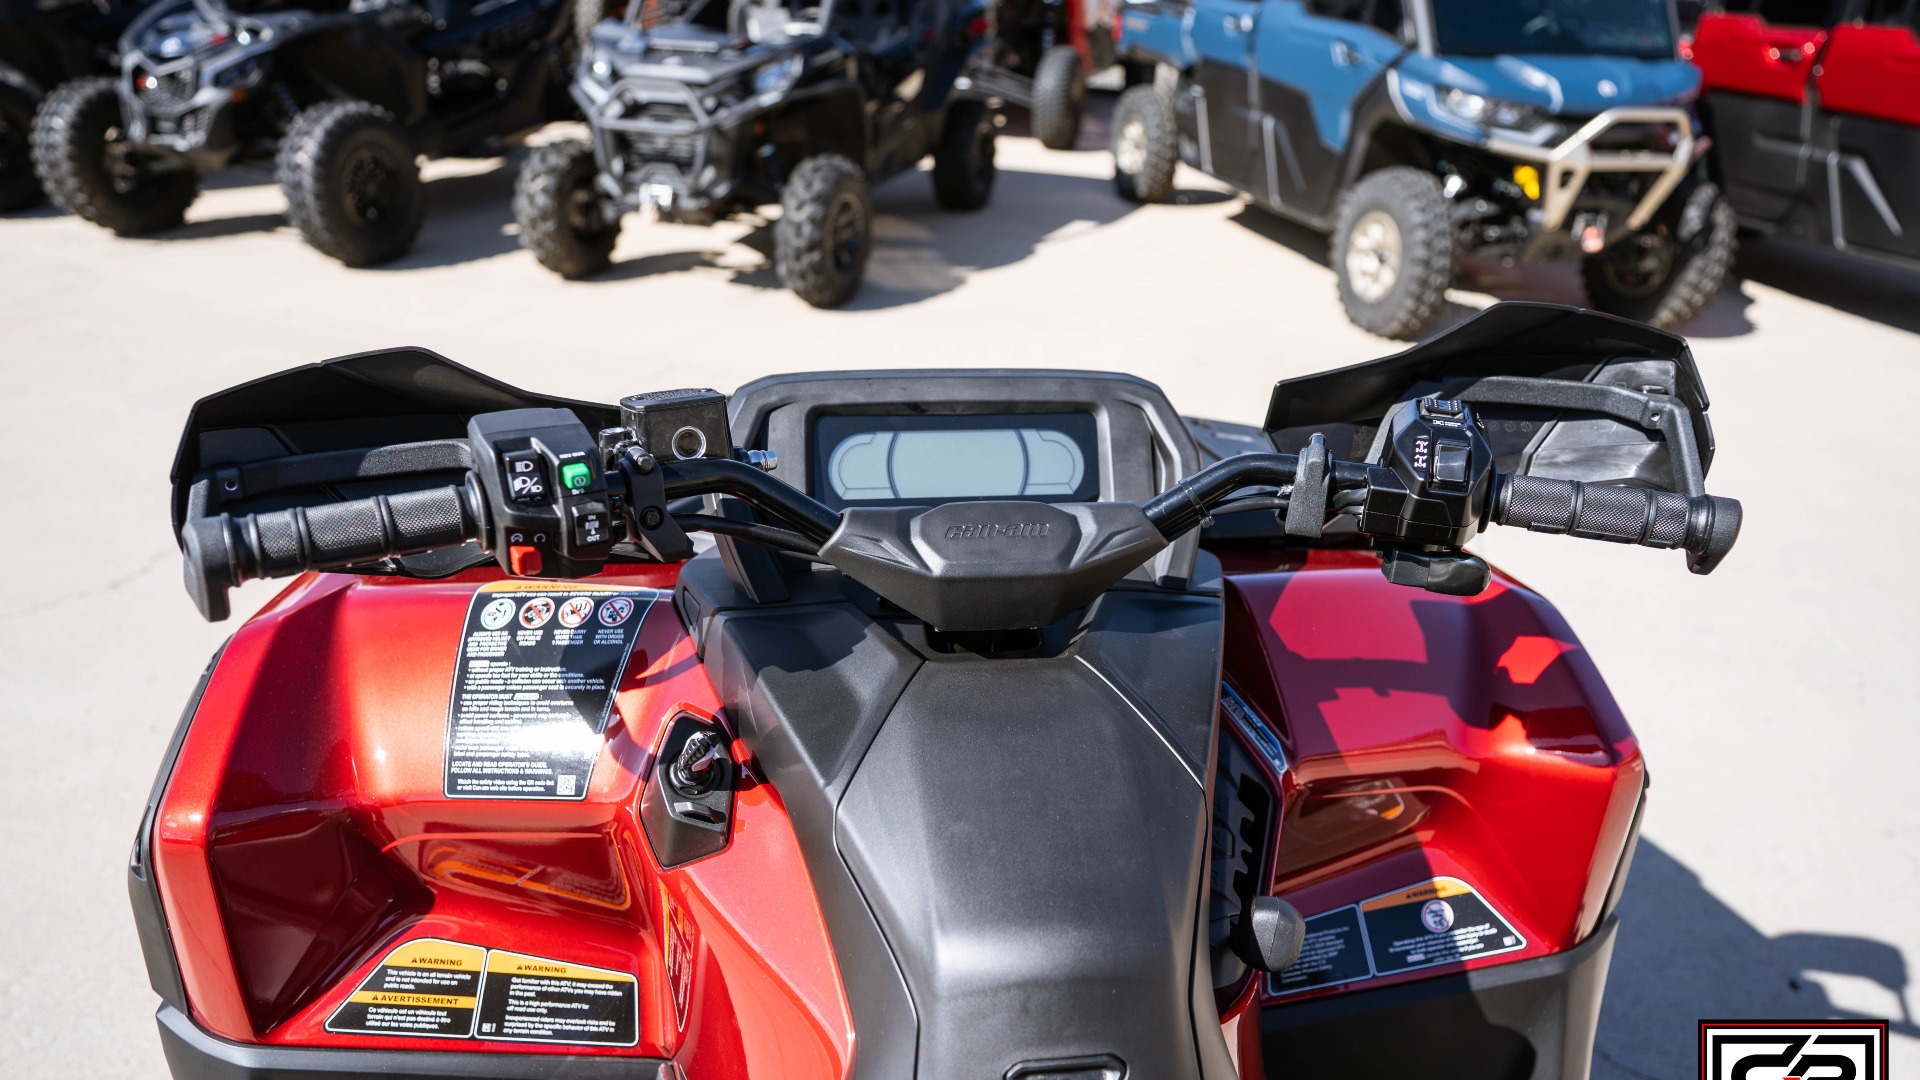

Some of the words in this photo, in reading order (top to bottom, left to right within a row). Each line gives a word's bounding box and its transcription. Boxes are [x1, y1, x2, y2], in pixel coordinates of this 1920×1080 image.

[945, 524, 1050, 540] can-am
[419, 958, 463, 967] WARNING
[524, 964, 567, 974] WARNING
[380, 995, 459, 1005] AVERTISSEMENT
